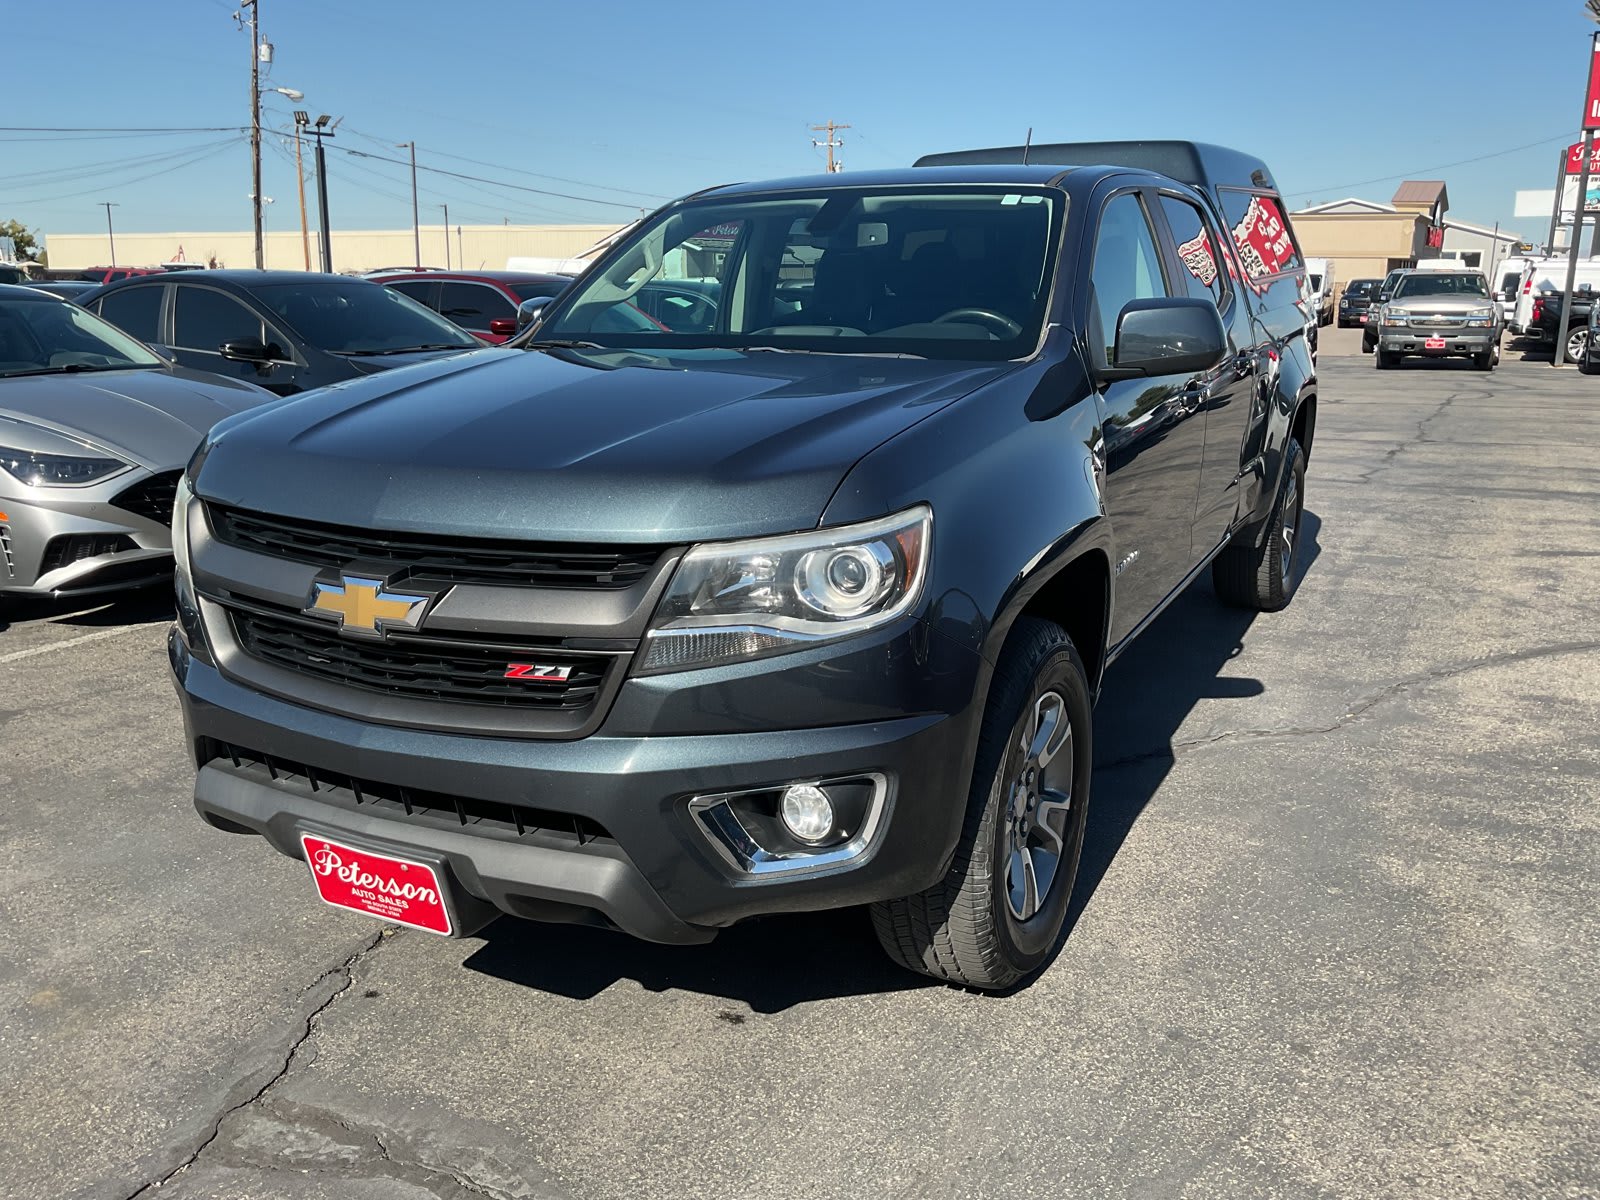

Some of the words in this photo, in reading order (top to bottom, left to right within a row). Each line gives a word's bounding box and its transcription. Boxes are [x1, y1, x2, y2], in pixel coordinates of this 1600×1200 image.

[504, 663, 572, 681] Z71
[315, 850, 438, 905] Peterson
[352, 887, 376, 901] AUTO
[378, 894, 409, 909] SALES
